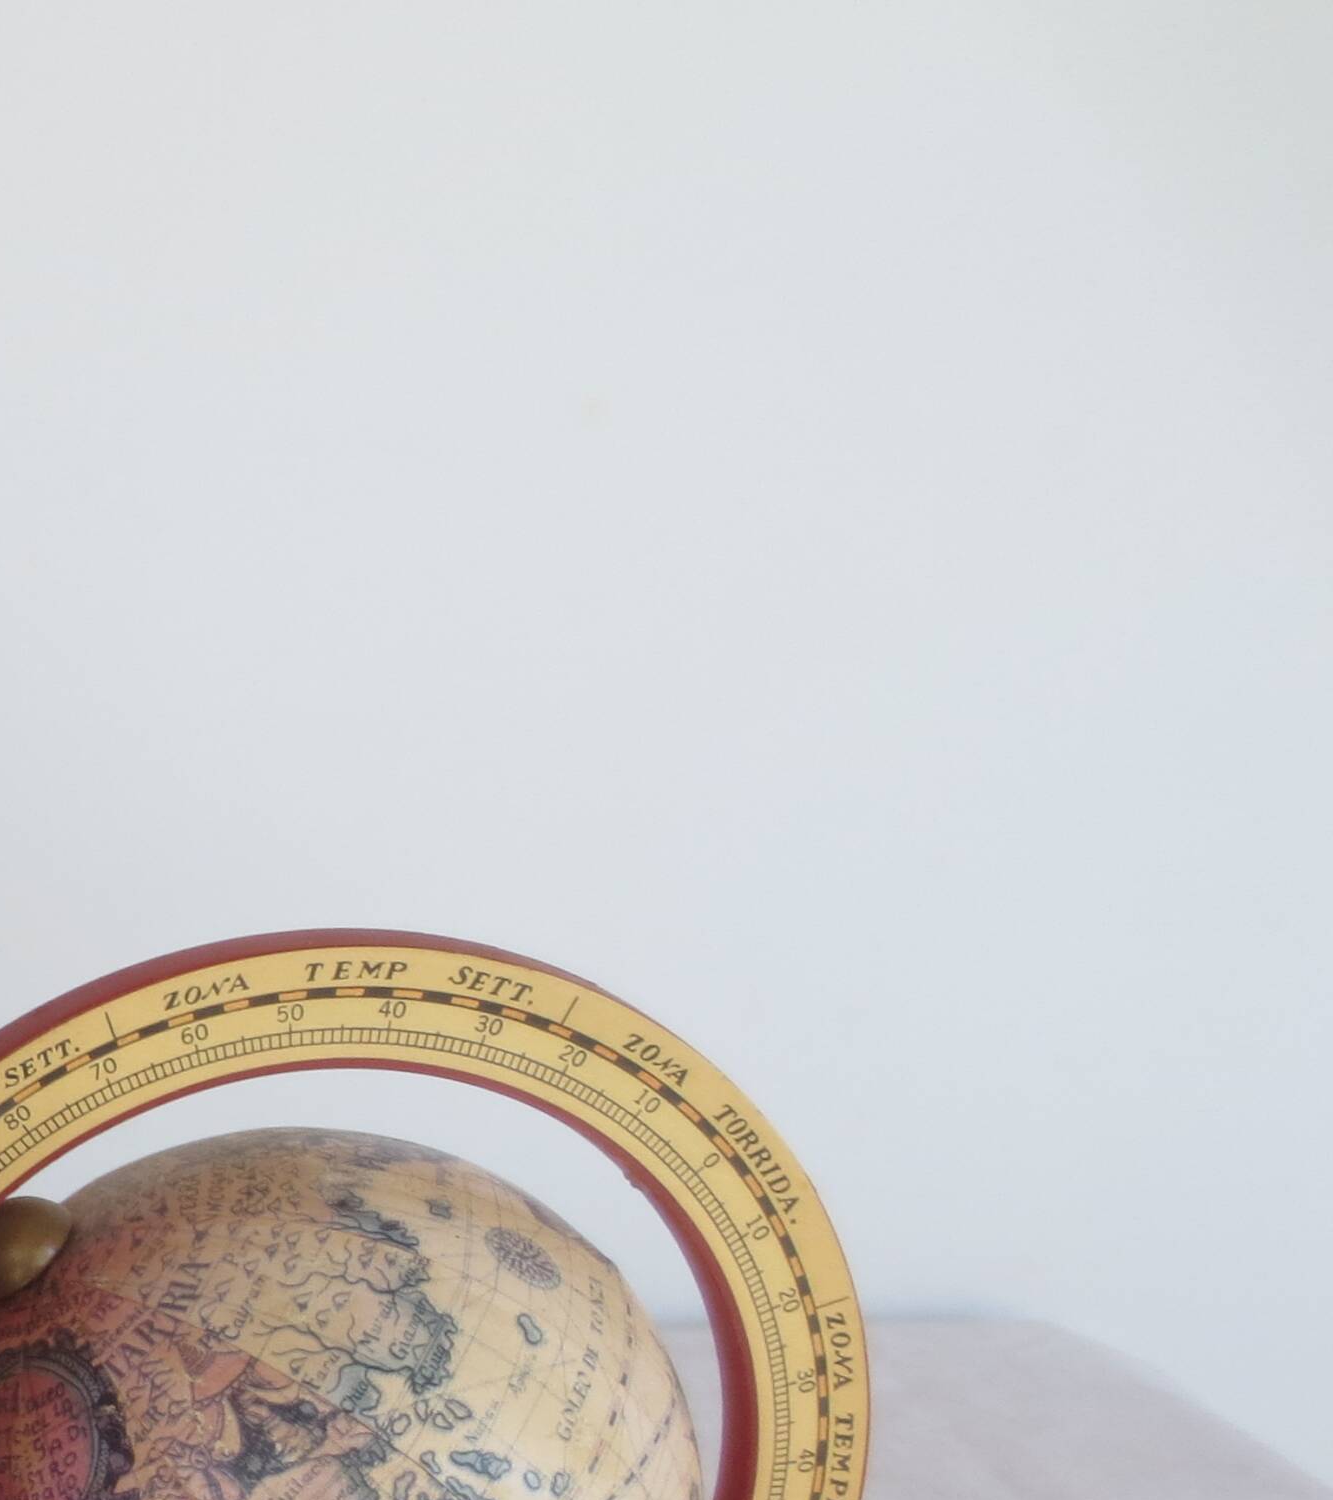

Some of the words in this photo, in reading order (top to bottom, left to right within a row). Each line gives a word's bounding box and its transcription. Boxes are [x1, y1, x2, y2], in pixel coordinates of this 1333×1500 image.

[163, 973, 250, 1011] ZONA
[305, 960, 408, 982] TEMP
[448, 965, 534, 1006] SETT.
[277, 1003, 304, 1023] 50
[379, 1000, 406, 1019] 40
[181, 1023, 209, 1045] 60
[474, 1015, 503, 1036] 30
[3, 1039, 80, 1088] SETT.
[558, 1044, 588, 1068] 20
[622, 1033, 689, 1088] ZONA
[89, 1057, 118, 1081] 70
[633, 1088, 661, 1113] 10
[3, 1104, 31, 1131] 80
[703, 1151, 720, 1169] 0
[745, 1213, 770, 1241] 10
[779, 1287, 801, 1313] 20
[825, 1312, 854, 1391] ZONA
[797, 1368, 815, 1394] 30
[797, 1448, 815, 1473] 40
